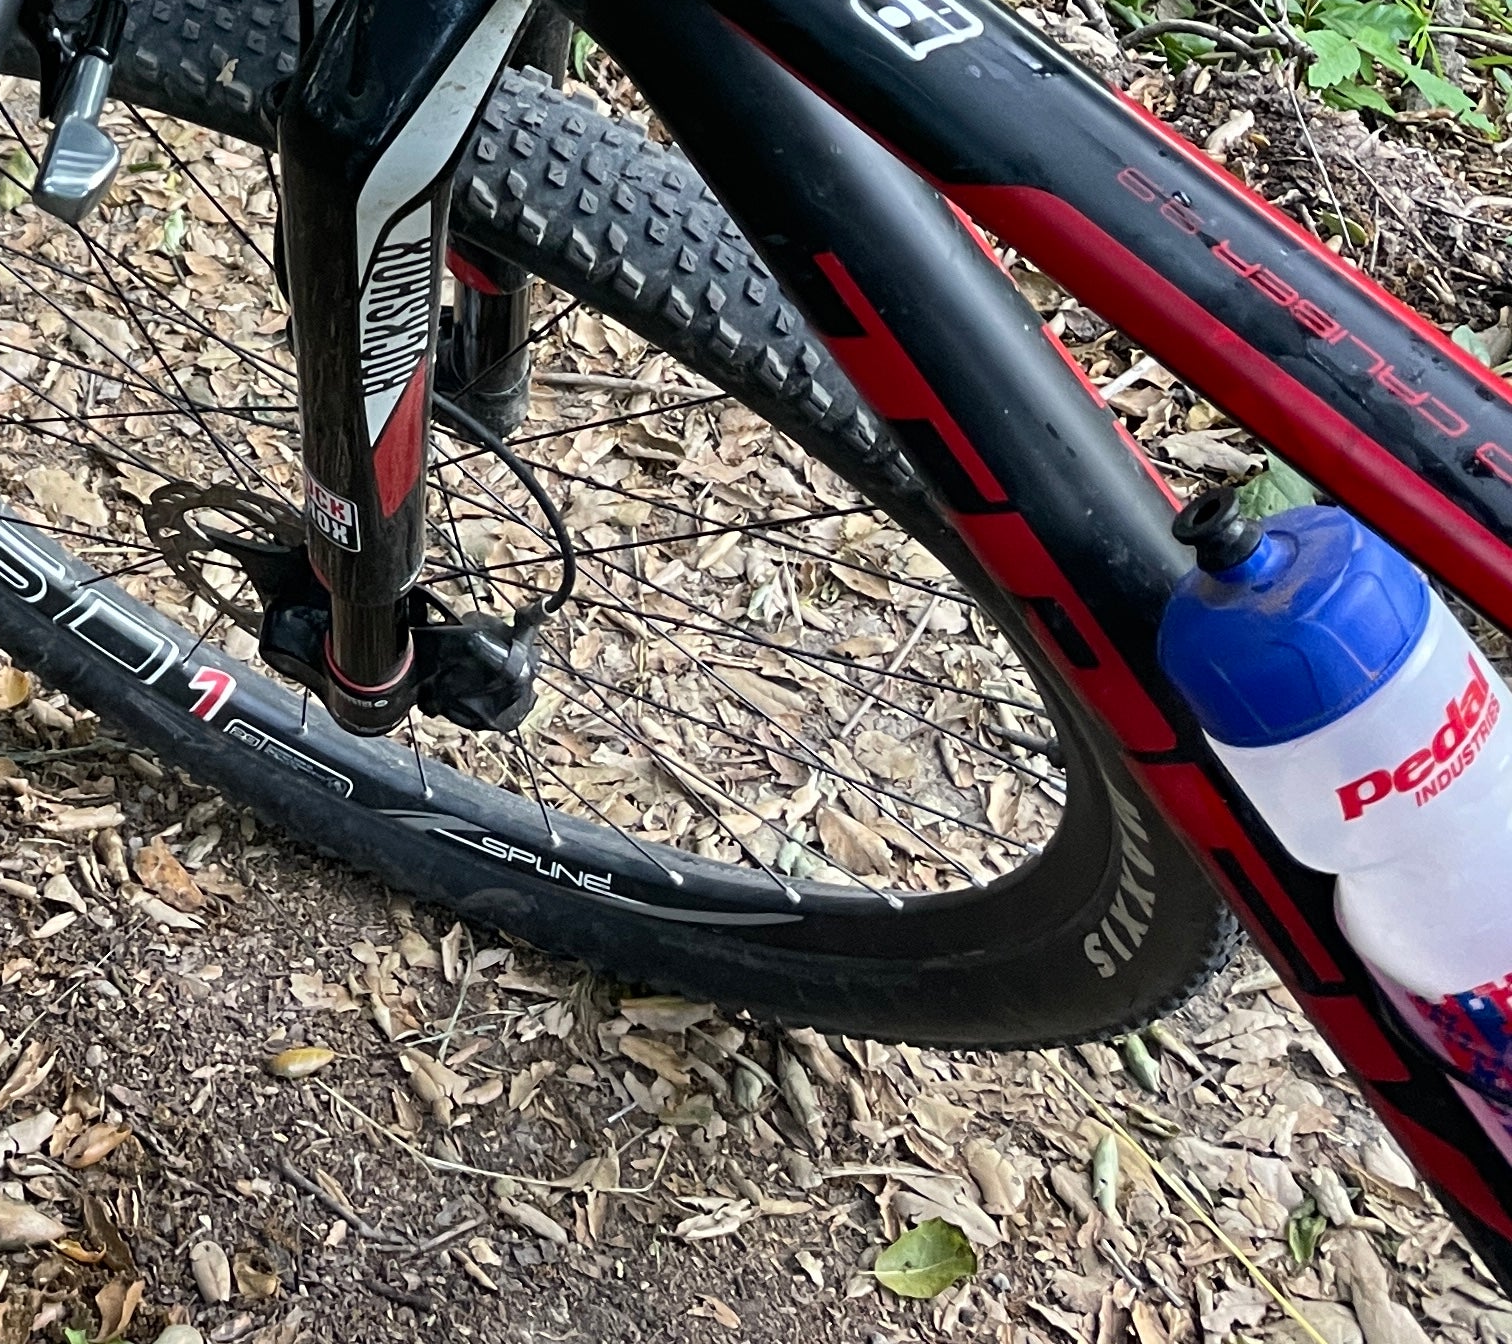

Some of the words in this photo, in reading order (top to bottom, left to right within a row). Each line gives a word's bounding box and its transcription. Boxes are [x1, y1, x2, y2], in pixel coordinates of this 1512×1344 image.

[1211, 239, 1470, 438] CALIBER
[1414, 692, 1501, 807] INDUSTRIES
[481, 836, 612, 892] SPLINE
[1083, 767, 1156, 979] MAXXIS
